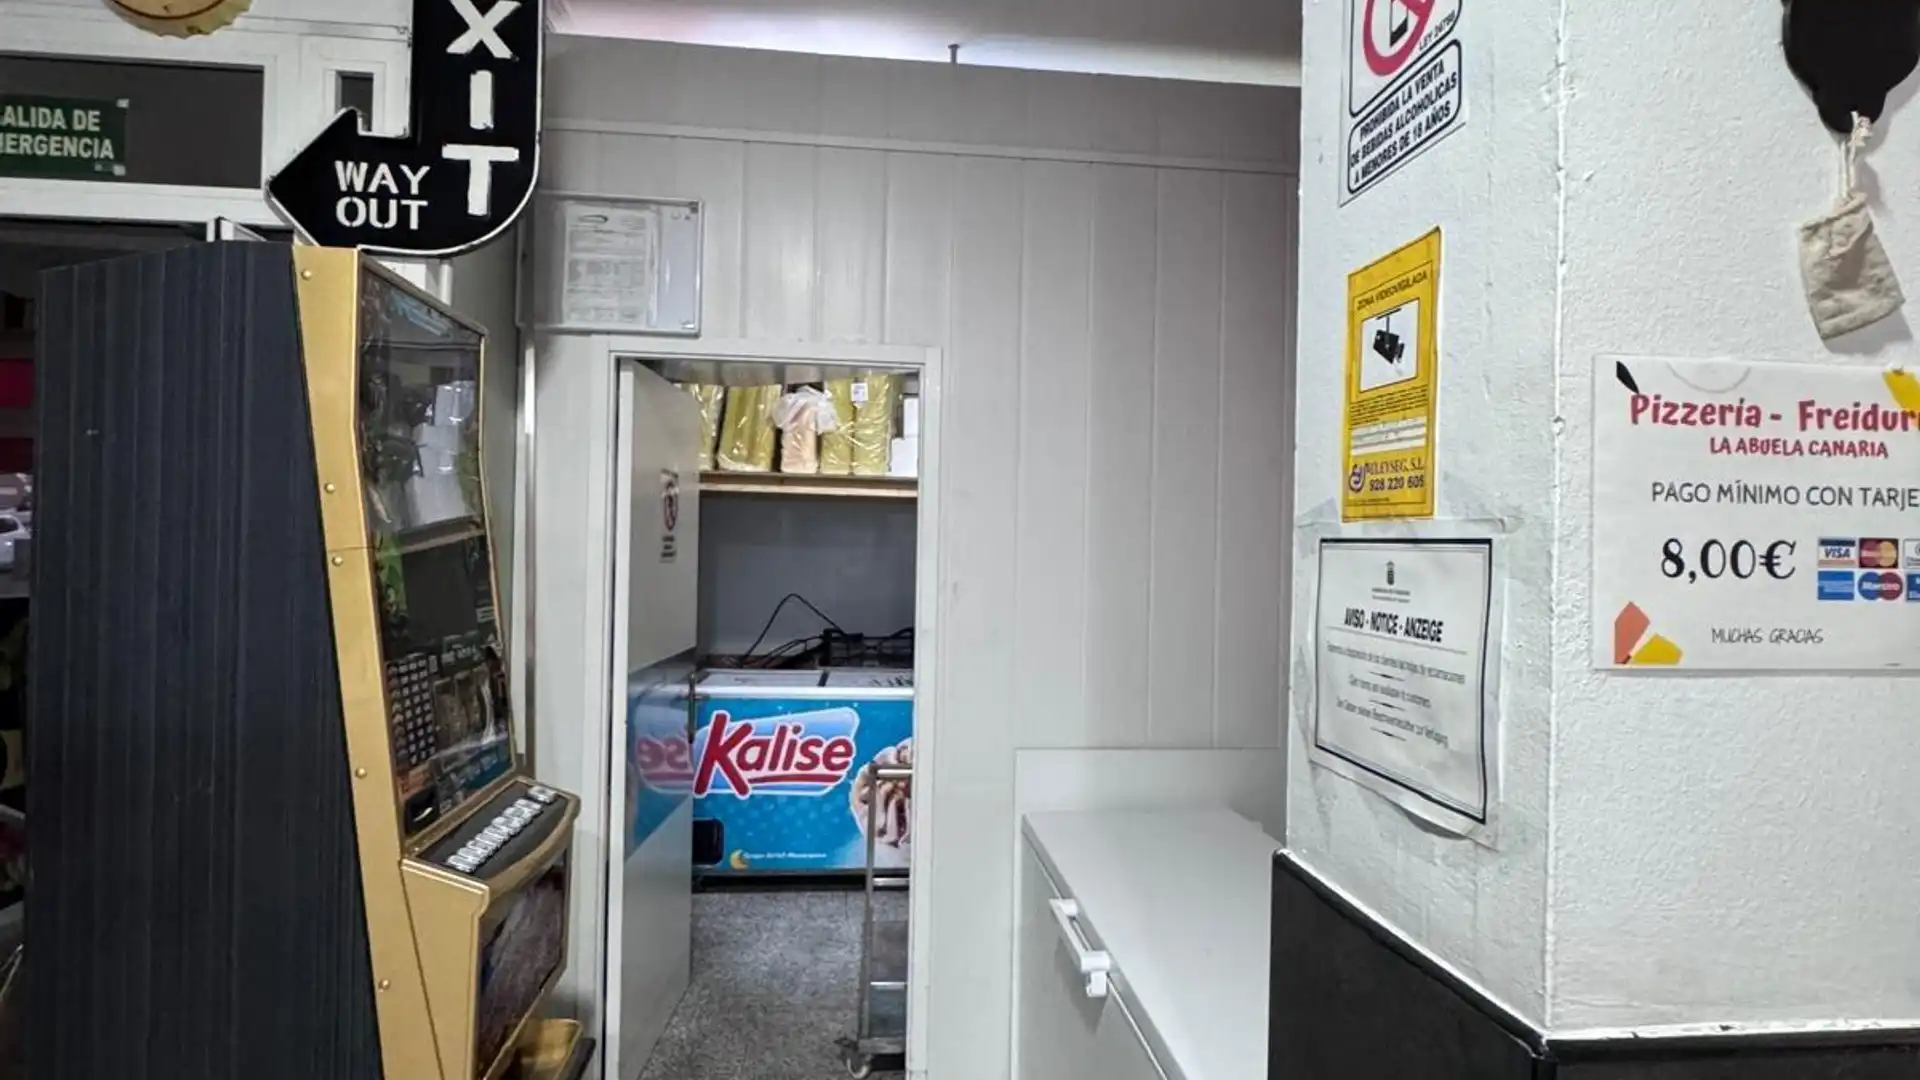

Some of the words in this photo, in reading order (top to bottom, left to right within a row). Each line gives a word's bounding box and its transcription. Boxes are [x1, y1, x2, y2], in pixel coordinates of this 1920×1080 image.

[1360, 96, 1400, 141] PROHIBIDA
[1402, 85, 1412, 105] LA
[1415, 58, 1444, 95] VENTA
[72, 109, 101, 132] DE
[0, 133, 115, 160] ERGENCIA
[1350, 150, 1360, 168] DE
[1362, 122, 1394, 159] BEBIDAS
[1362, 141, 1398, 180] MENORES
[1400, 130, 1410, 151] DE
[1413, 122, 1422, 141] 18
[1425, 100, 1450, 132] AÑOS
[334, 160, 430, 196] WAY
[335, 196, 428, 230] OUT
[1357, 295, 1375, 311] ZONA
[1630, 393, 1762, 427] Pizzería
[1797, 400, 1920, 432] Freidur
[1709, 436, 1731, 455] LA
[1735, 437, 1804, 457] ABUELA
[1808, 440, 1889, 459] CANARIA
[1388, 476, 1404, 490] 220
[1652, 482, 1711, 503] PAGO
[1716, 480, 1800, 506] MÍNIMO
[1806, 486, 1853, 506] CON
[1860, 487, 1920, 512] TARJE
[1661, 537, 1797, 584] 8,00€
[1824, 547, 1852, 559] VISA
[1344, 607, 1365, 629] AVISO
[1370, 611, 1399, 635] NOTICE
[1404, 616, 1444, 643] ANZEIGE
[1711, 628, 1763, 644] MUCHAS
[1769, 627, 1824, 645] GRACIAS
[693, 711, 855, 798] Kalise
